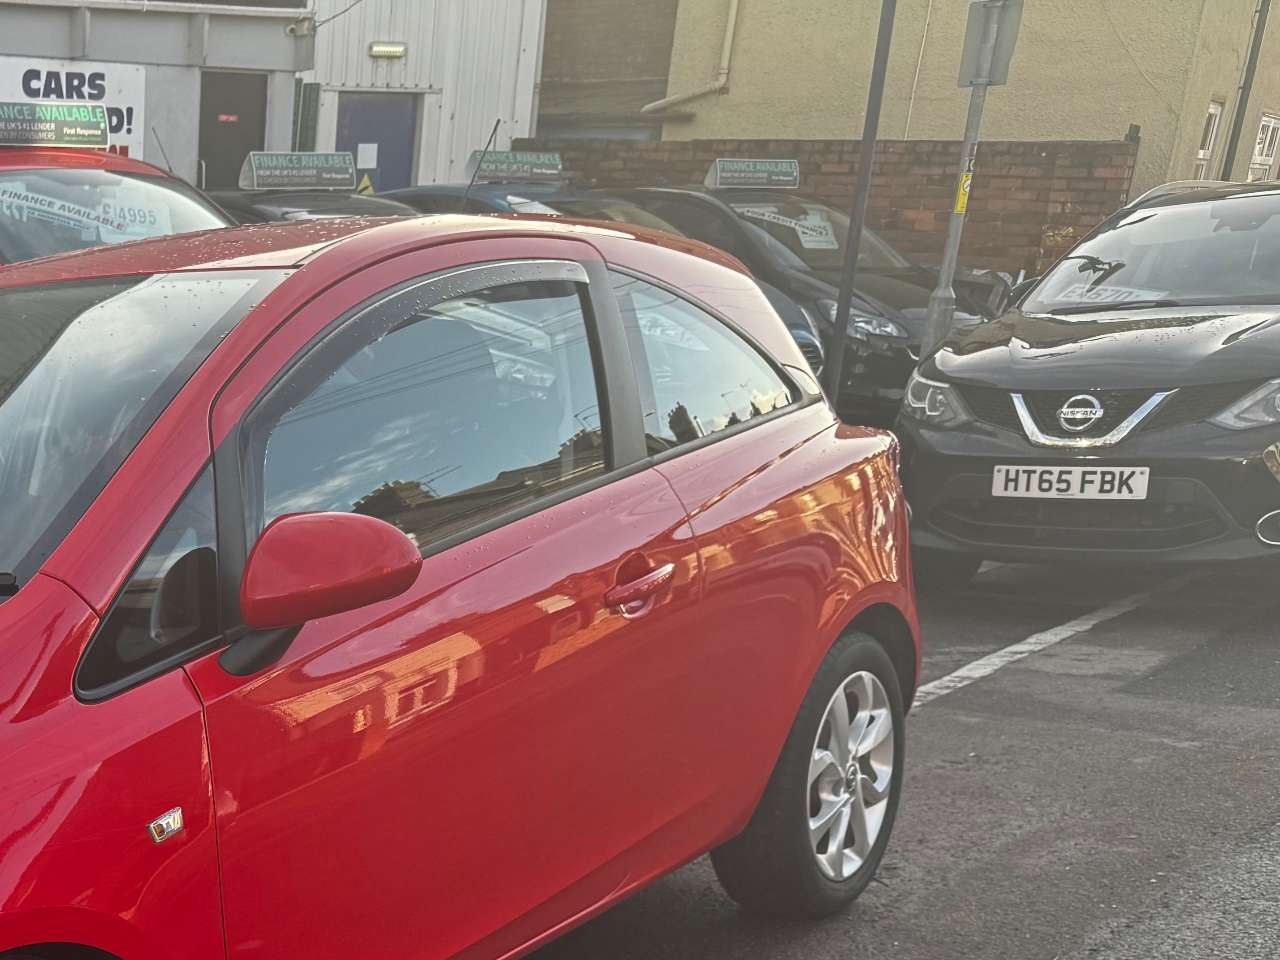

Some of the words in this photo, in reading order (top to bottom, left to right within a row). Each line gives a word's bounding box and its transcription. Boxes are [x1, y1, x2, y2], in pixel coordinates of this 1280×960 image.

[22, 68, 106, 101] CARS
[35, 105, 105, 122] AVAILABLE
[1, 189, 56, 210] FINANCE
[58, 203, 127, 232] AVAILABLE
[1003, 469, 1073, 494] HT65
[1079, 470, 1137, 495] FBK
